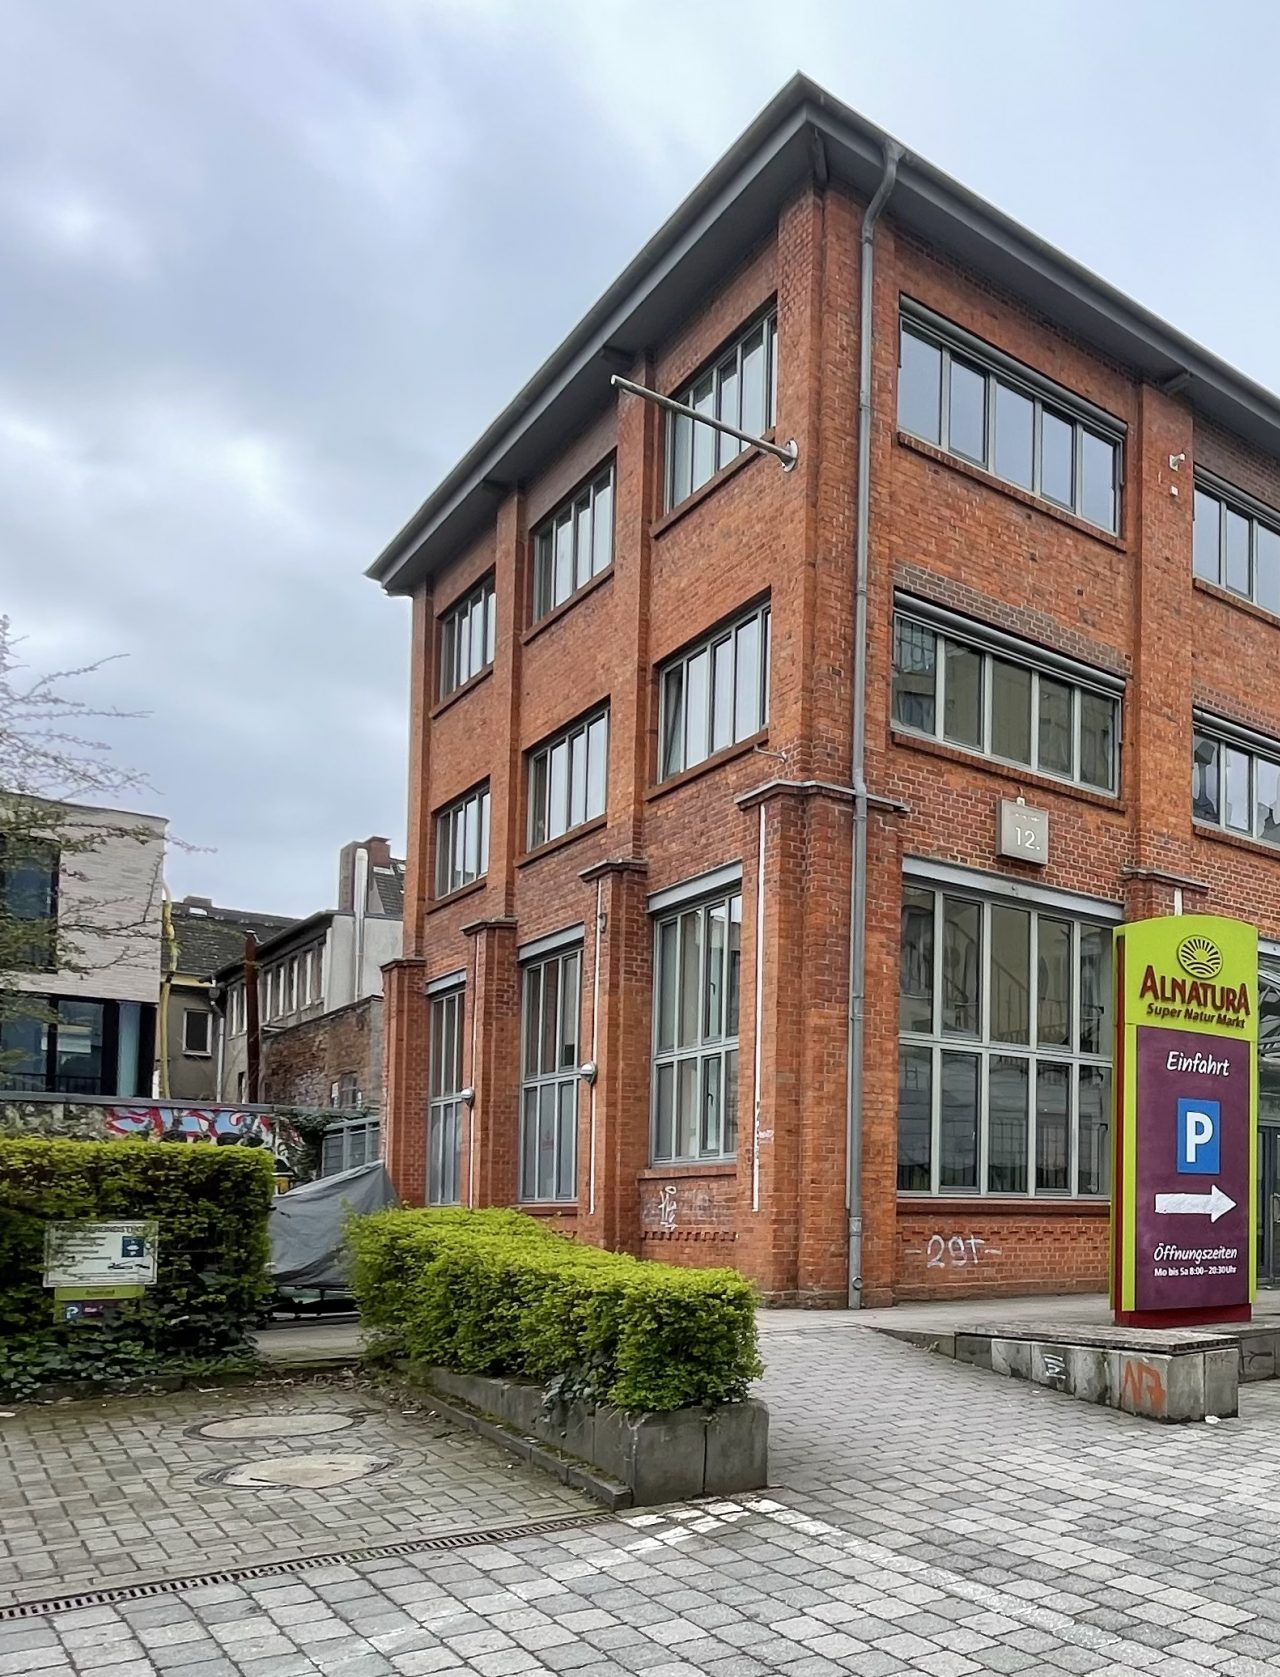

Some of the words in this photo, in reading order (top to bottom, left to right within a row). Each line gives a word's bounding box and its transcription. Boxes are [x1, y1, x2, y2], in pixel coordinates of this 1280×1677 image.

[1139, 965, 1250, 1016] ALNATURA
[1146, 1002, 1182, 1018] Super
[1184, 1008, 1216, 1023] Natur
[1217, 1013, 1245, 1028] Markt
[1166, 1051, 1230, 1076] Einfahrt
[1186, 1111, 1213, 1163] P
[1154, 1243, 1237, 1264] Öffnungszeiten
[1154, 1268, 1167, 1276] Mo
[1168, 1266, 1179, 1276] bis
[1180, 1266, 1188, 1276] Sa
[1225, 1264, 1237, 1274] Uhr
